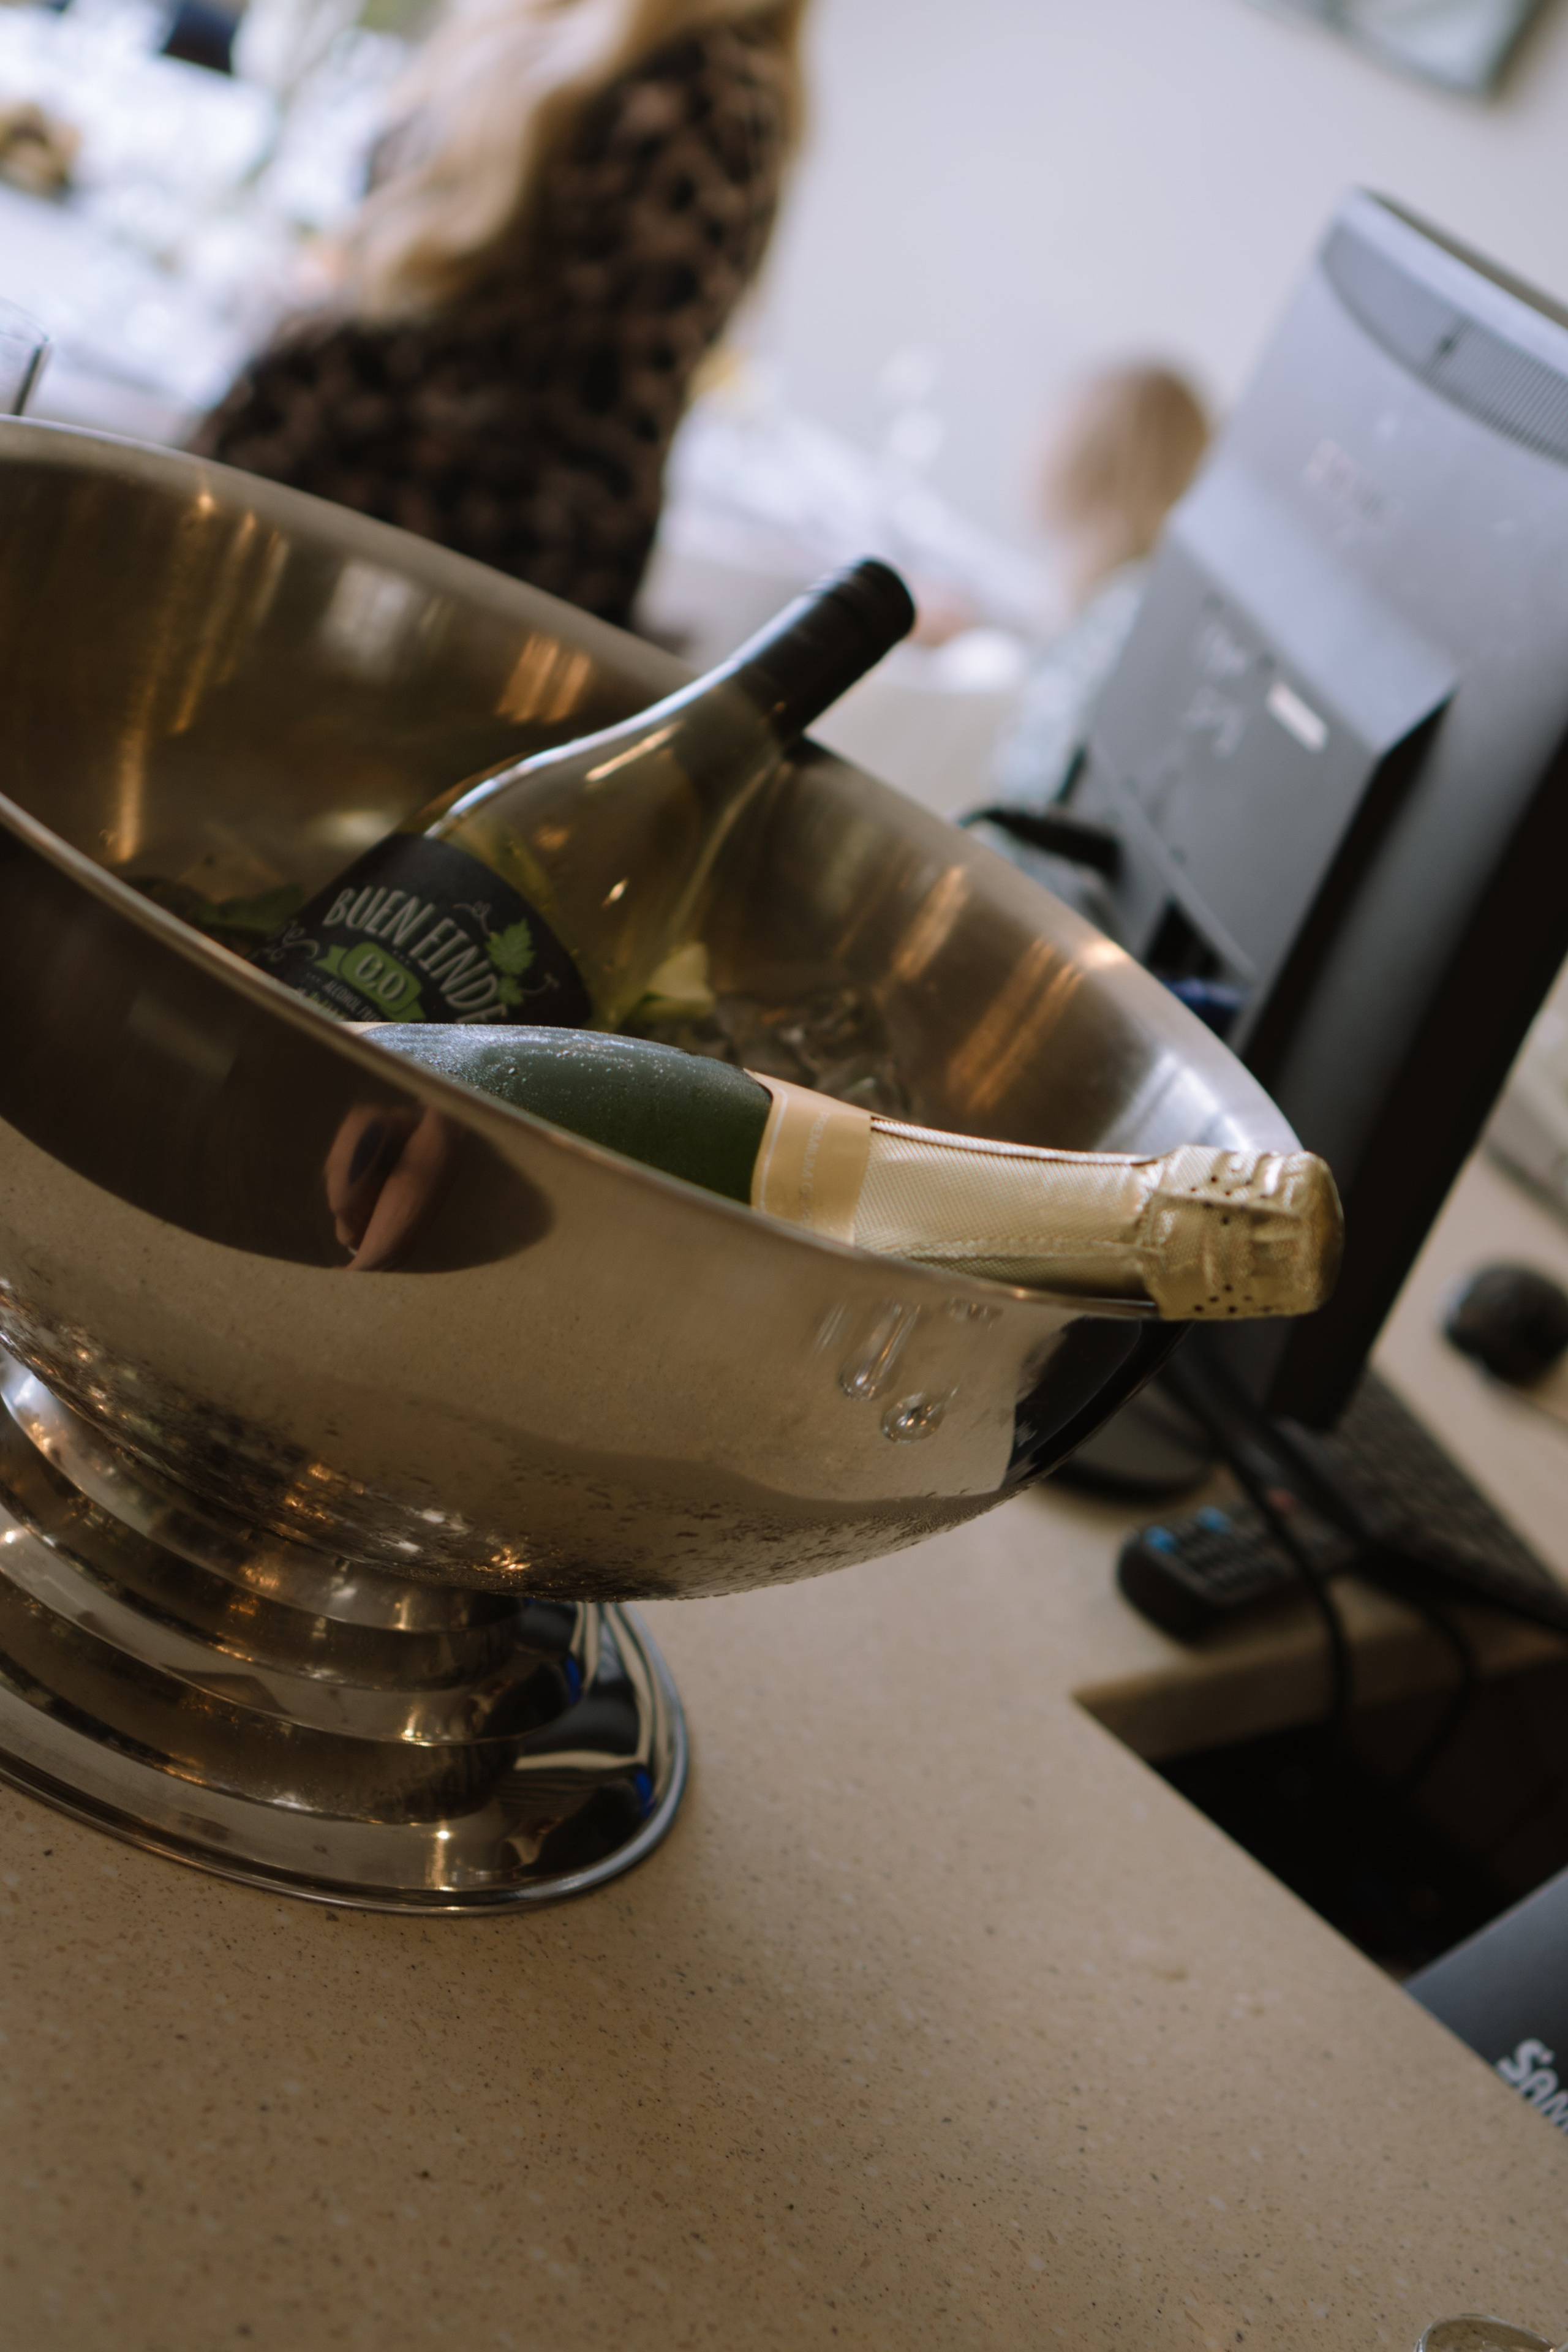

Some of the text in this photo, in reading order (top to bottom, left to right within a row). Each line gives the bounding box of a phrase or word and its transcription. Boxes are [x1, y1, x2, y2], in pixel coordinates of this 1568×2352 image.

[322, 886, 437, 947] BUEN
[322, 979, 363, 1012] ALCOHOL
[802, 1110, 831, 1178] PREMIUM
